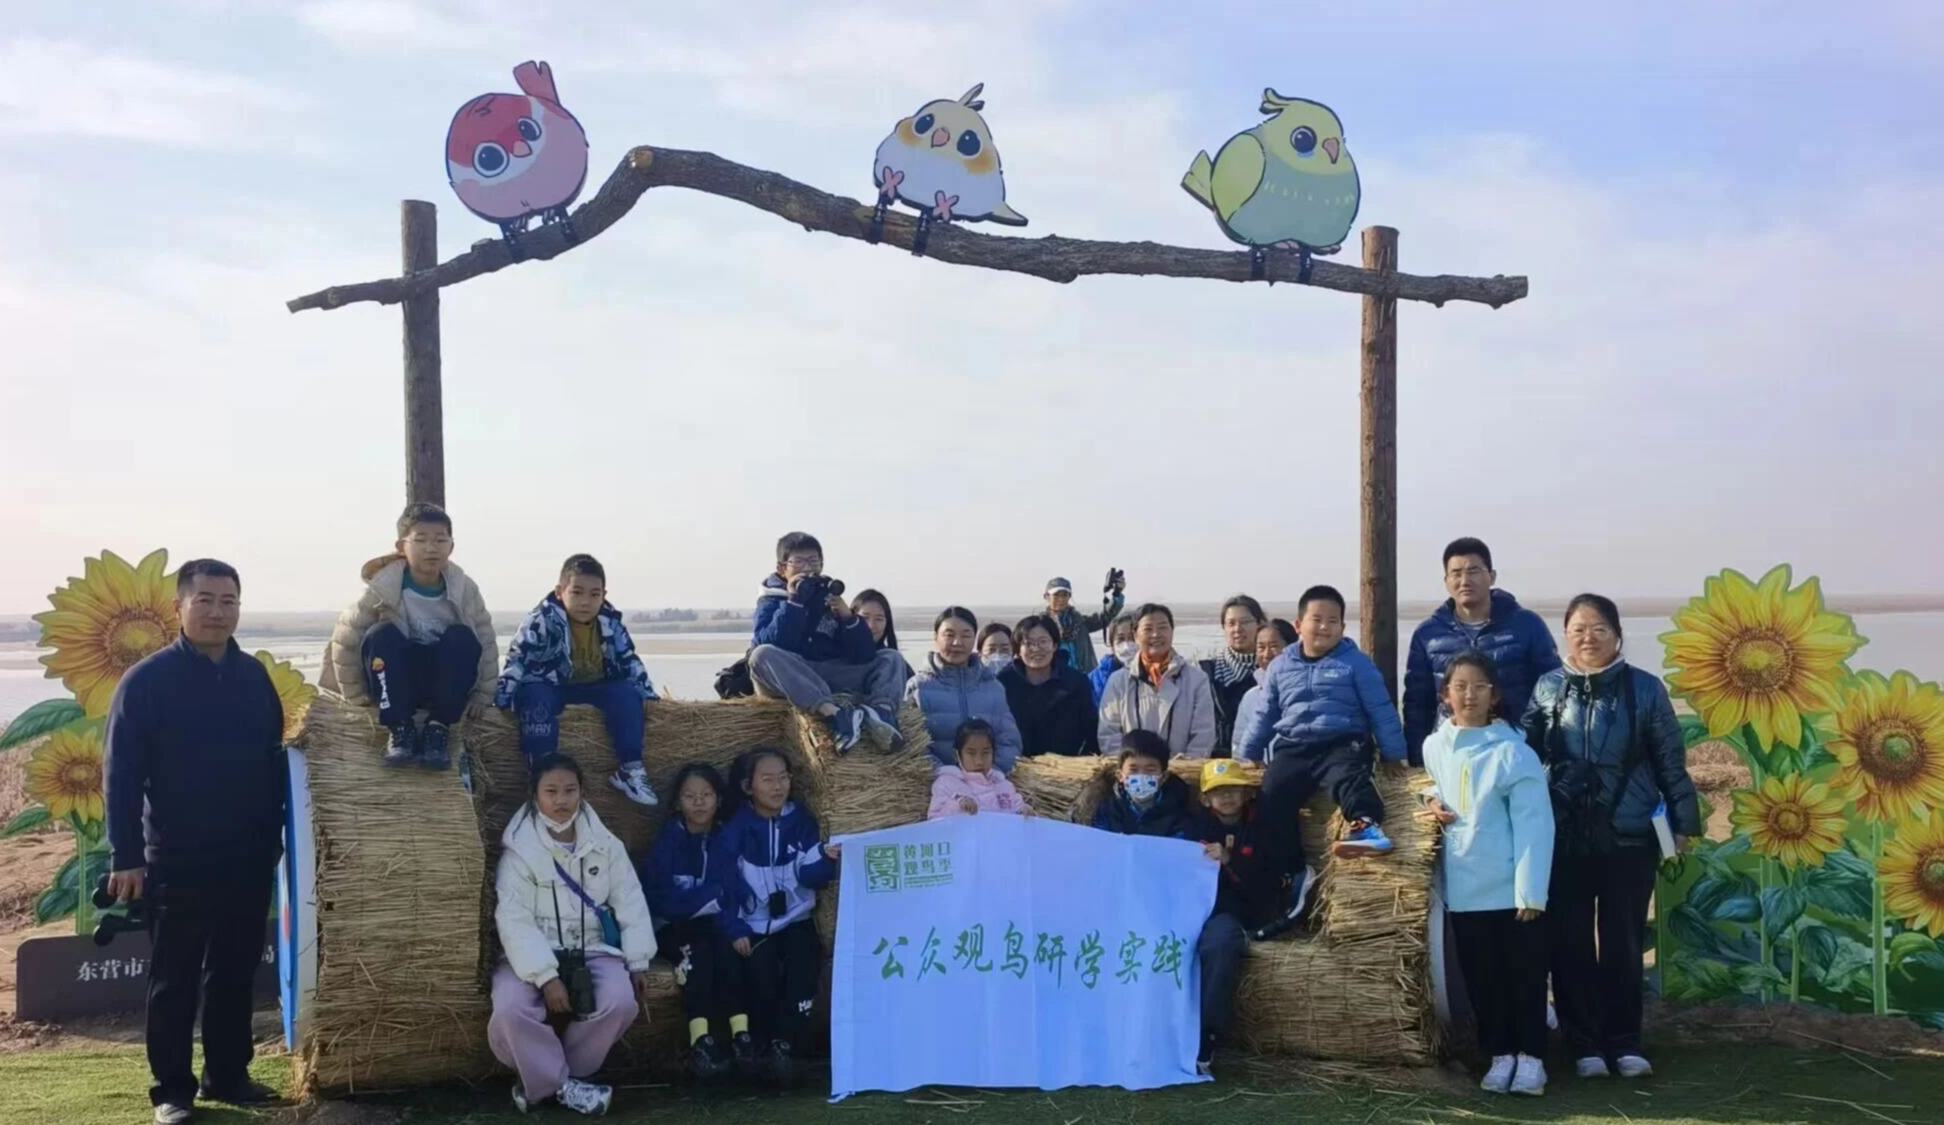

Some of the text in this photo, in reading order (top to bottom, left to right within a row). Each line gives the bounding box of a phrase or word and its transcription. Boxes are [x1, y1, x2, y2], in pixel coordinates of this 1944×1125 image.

[76, 957, 151, 982] 东营市
[872, 919, 1187, 990] 公众观鸟研学实践
